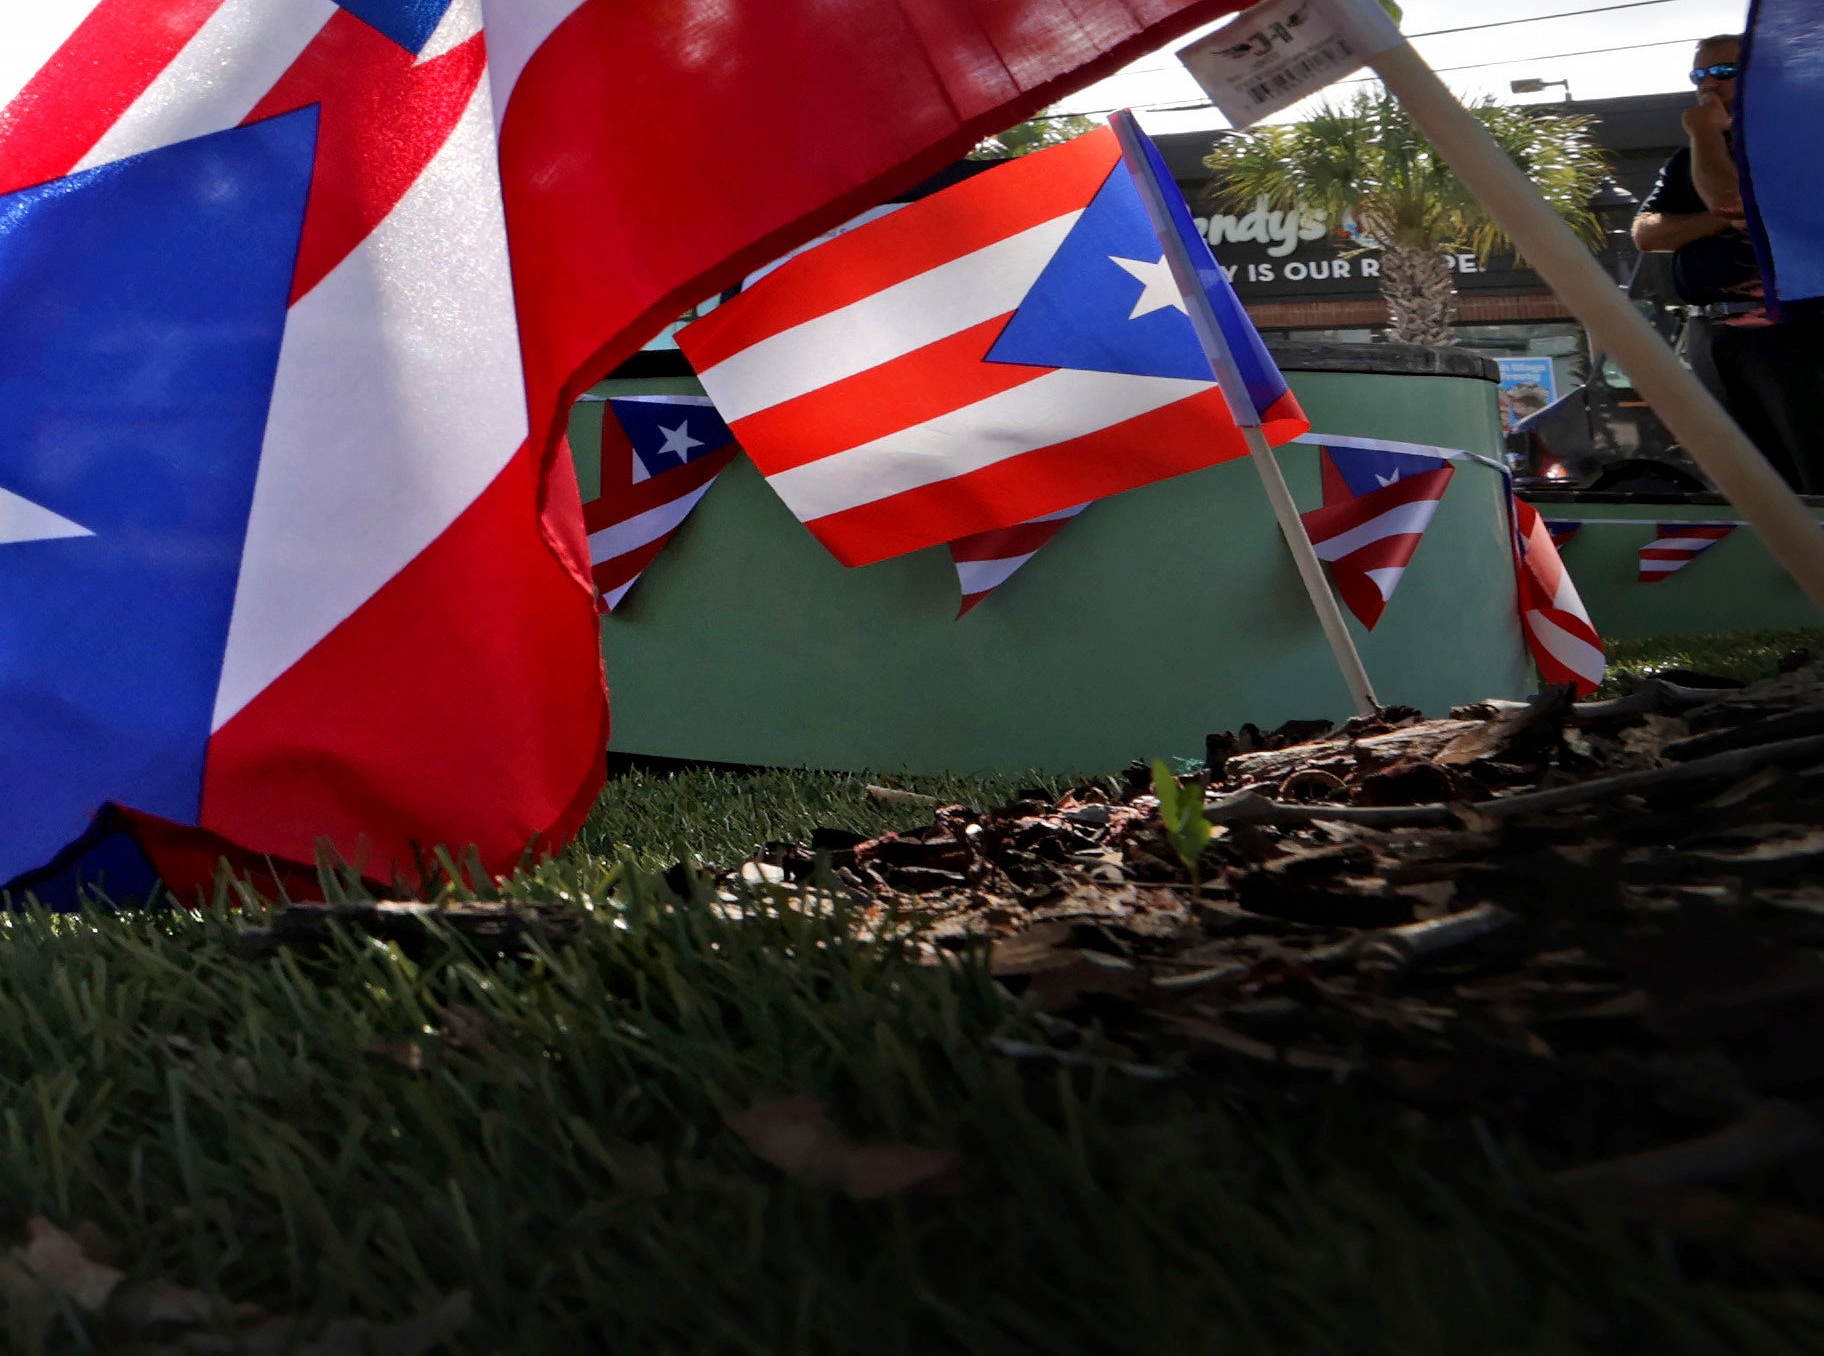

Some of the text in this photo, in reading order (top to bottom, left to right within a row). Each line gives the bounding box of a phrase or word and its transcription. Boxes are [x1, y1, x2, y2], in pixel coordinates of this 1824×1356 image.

[1193, 194, 1328, 257] endy's
[1248, 263, 1276, 283] IS
[1283, 258, 1351, 282] OUR
